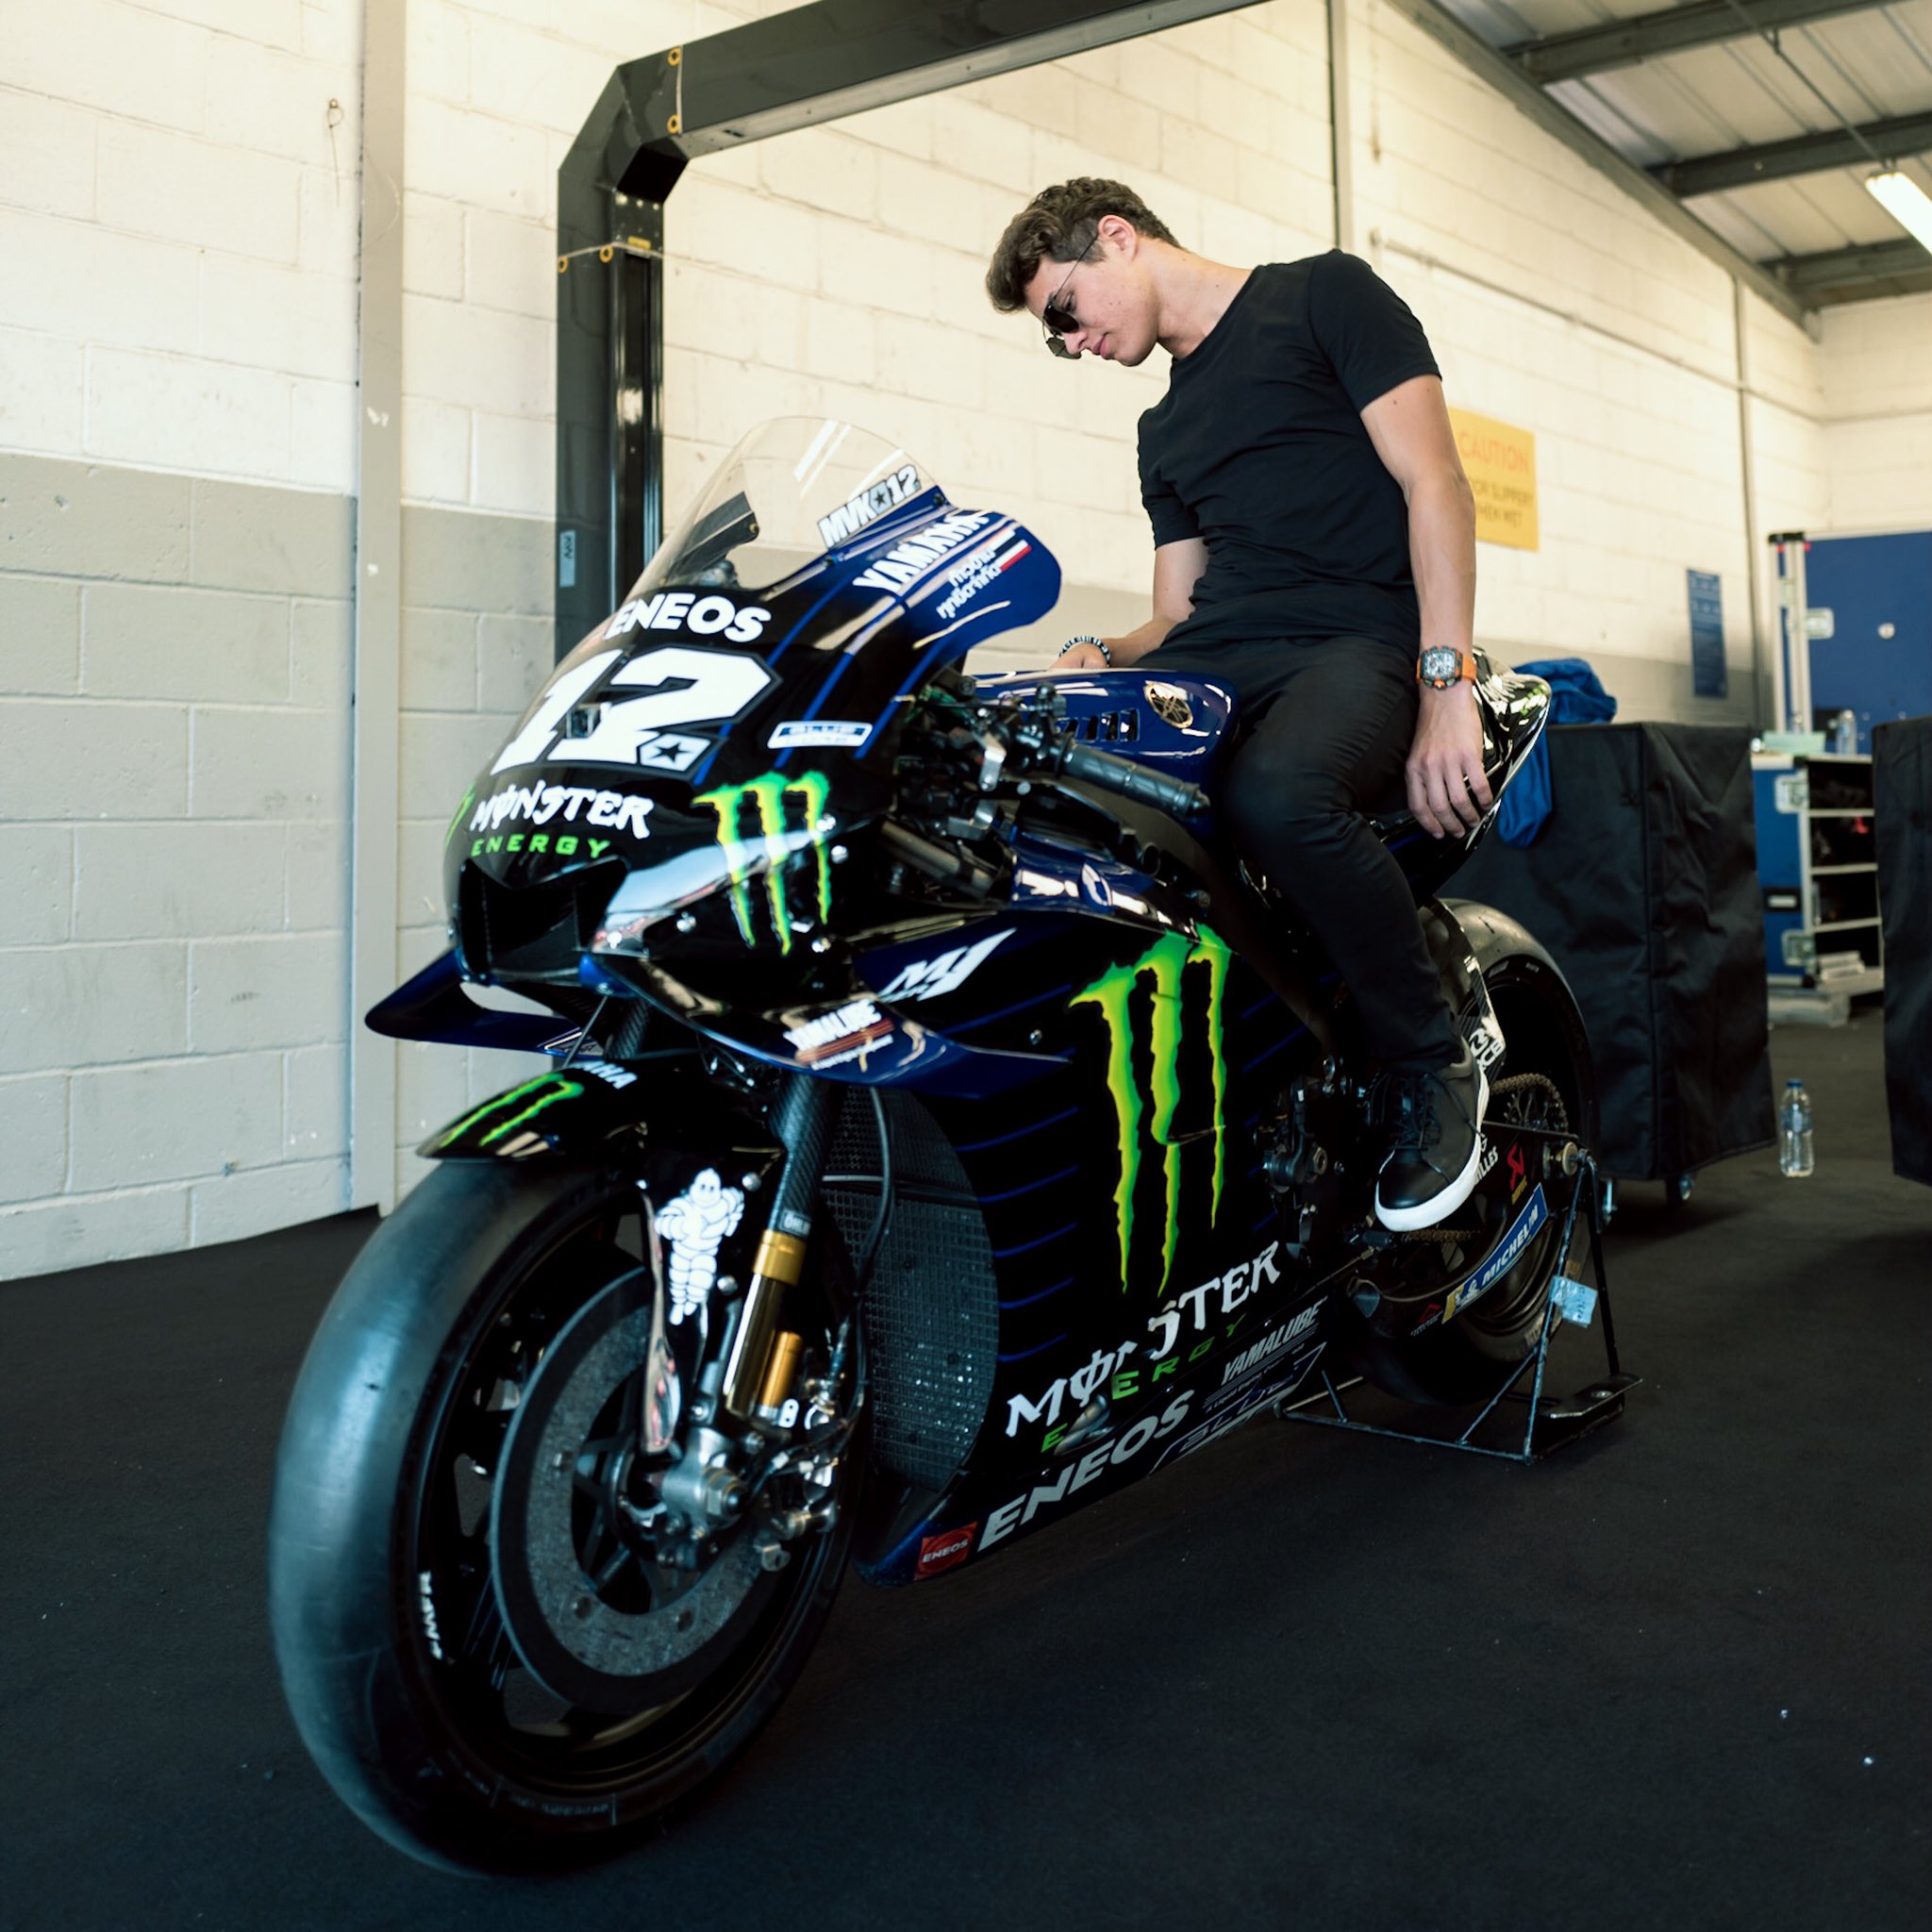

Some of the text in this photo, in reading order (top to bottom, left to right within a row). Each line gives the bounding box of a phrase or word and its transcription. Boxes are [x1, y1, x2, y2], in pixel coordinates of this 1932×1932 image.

[1458, 429, 1529, 475] CAUTION
[819, 463, 922, 548] MVK 12
[604, 592, 773, 642] ENEOS
[490, 647, 772, 776] 12
[470, 779, 655, 840] MONSTER
[471, 833, 611, 859] ENERGY
[1475, 1145, 1499, 1181] ILLES
[1482, 1204, 1540, 1286] MICHELIN
[1221, 1296, 1328, 1387] YAMALUBE
[1041, 1313, 1247, 1453] EERGY
[977, 1389, 1195, 1553] ENEOS
[922, 1539, 969, 1564] ENEOS
